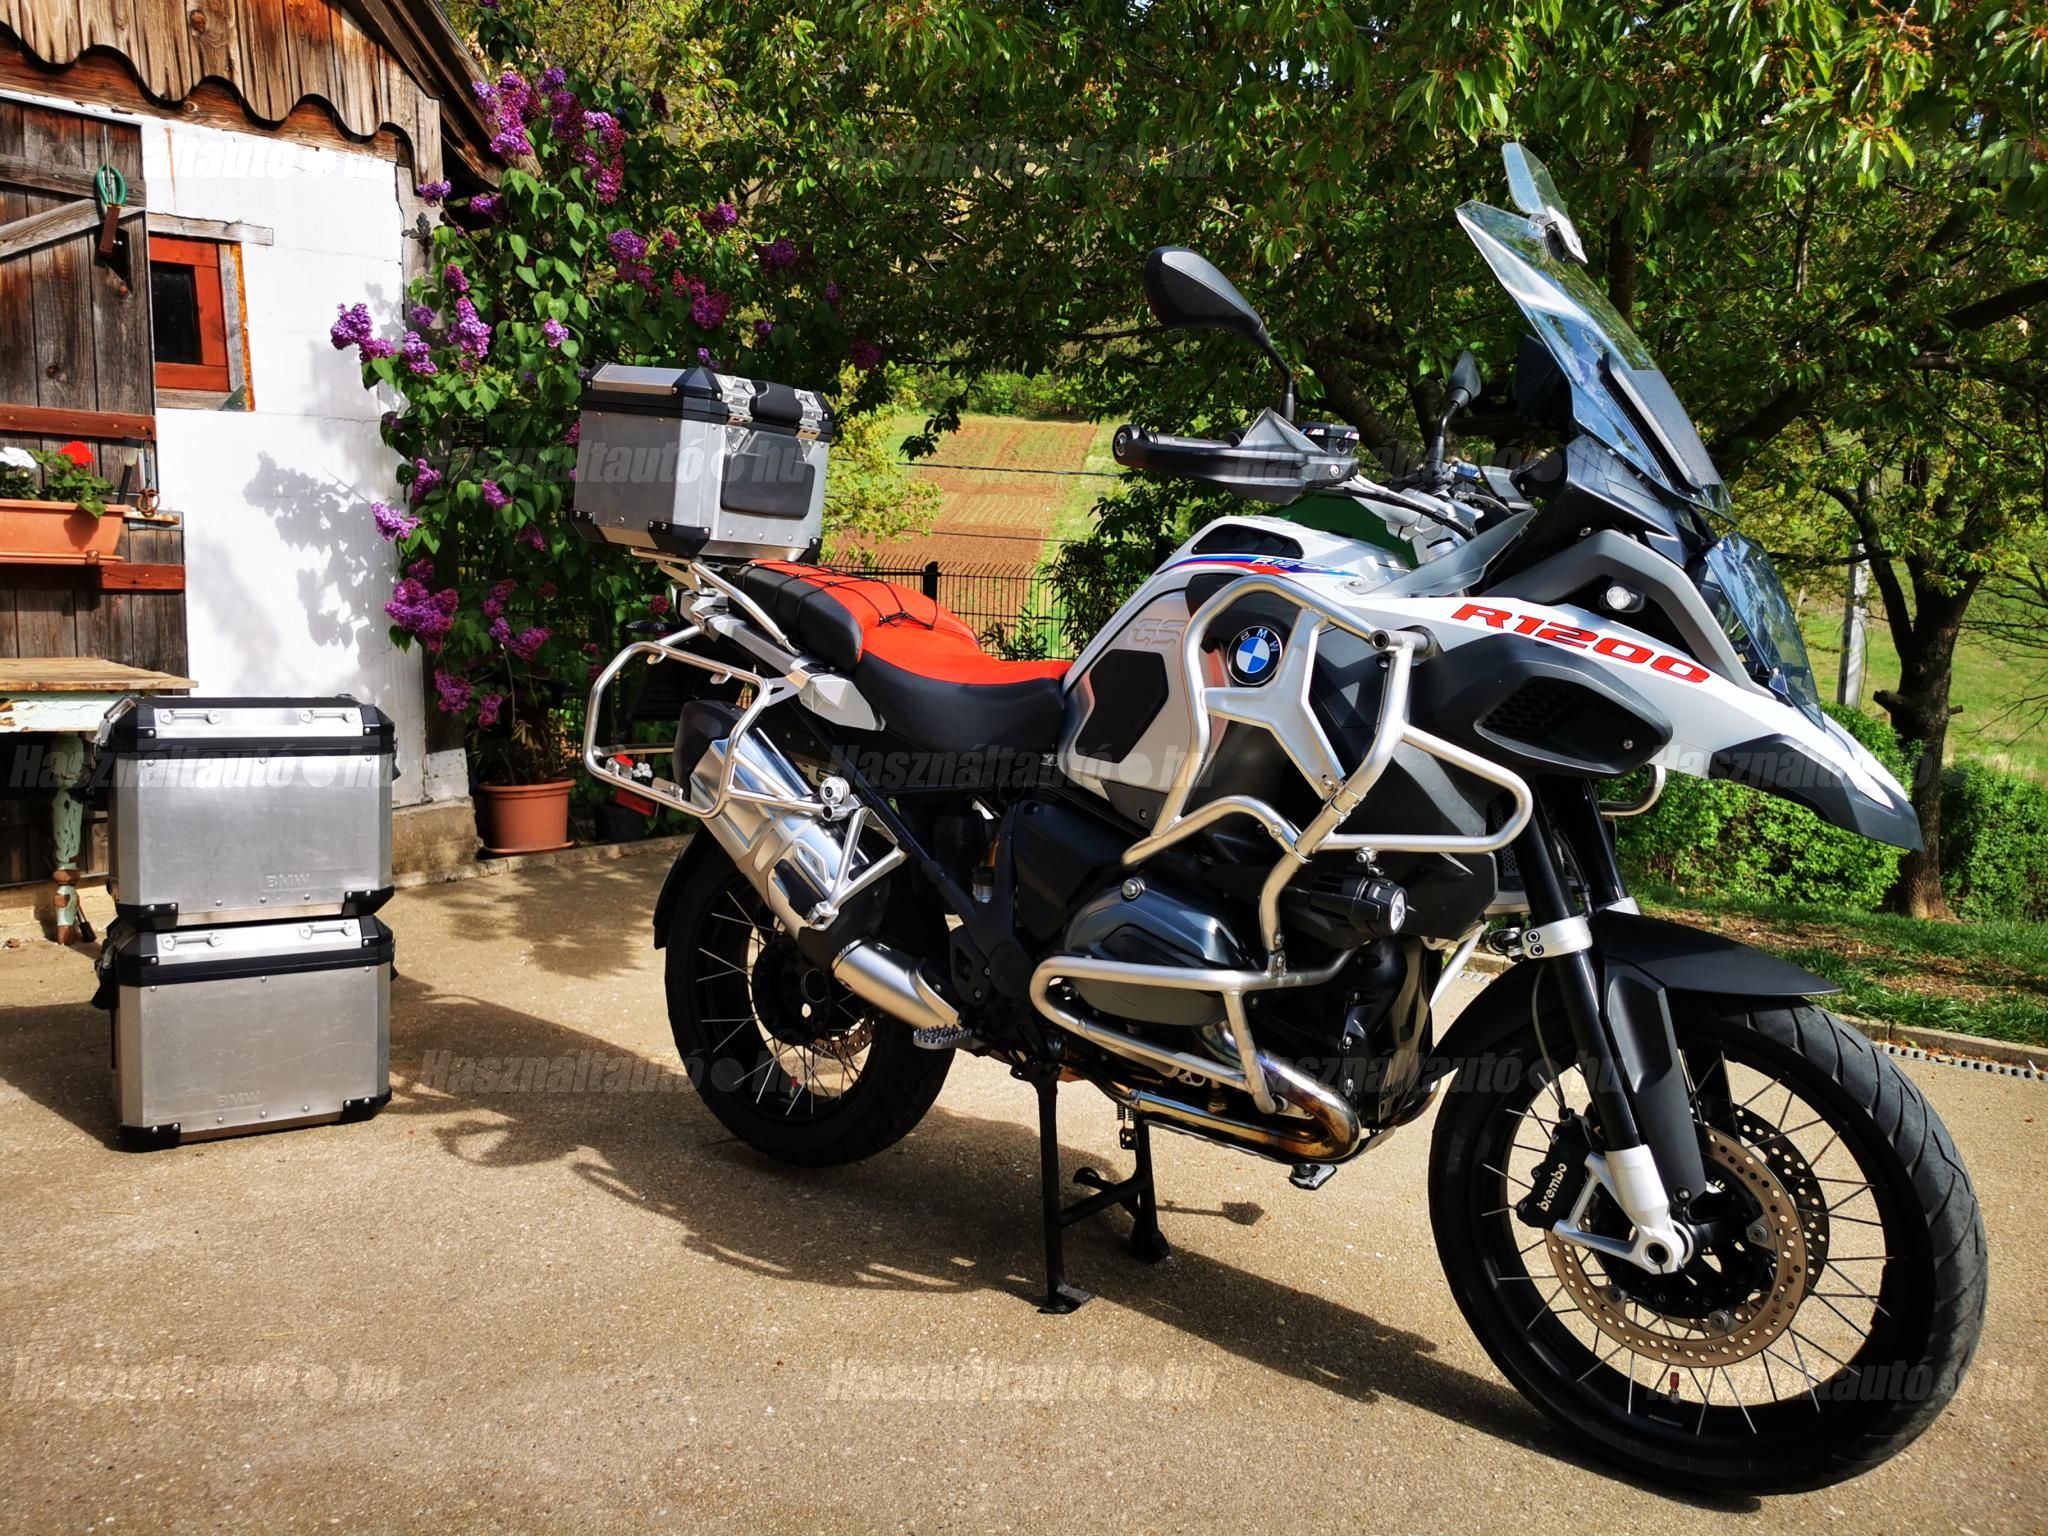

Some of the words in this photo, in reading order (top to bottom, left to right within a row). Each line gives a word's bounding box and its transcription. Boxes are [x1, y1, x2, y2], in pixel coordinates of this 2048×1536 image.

[1451, 603, 1710, 683] R1200
[263, 872, 310, 889] BMW
[1536, 1162, 1567, 1212] brembo
